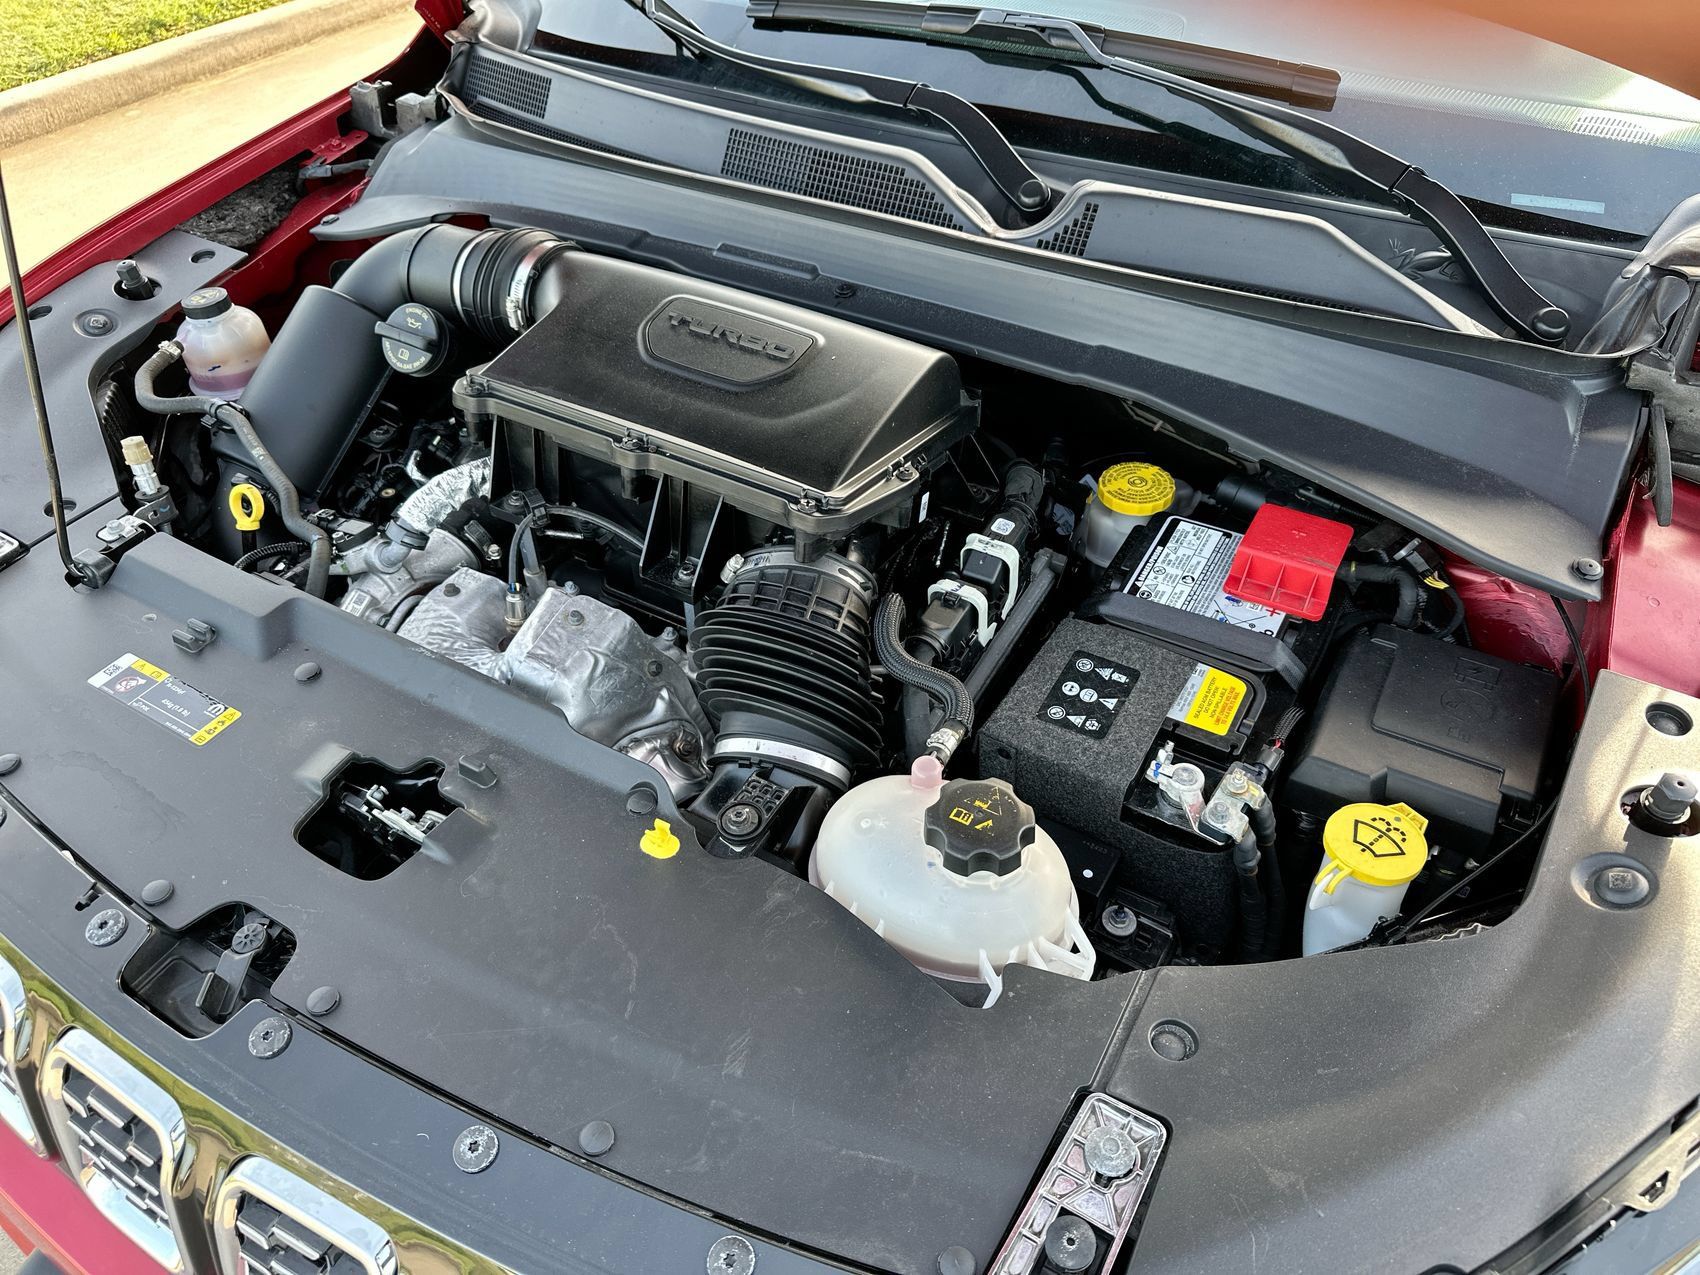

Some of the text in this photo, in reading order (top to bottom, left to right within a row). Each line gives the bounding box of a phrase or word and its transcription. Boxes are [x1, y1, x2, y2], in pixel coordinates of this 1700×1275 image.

[668, 311, 796, 360] TURBO
[1194, 702, 1205, 719] SEALED
[1206, 677, 1217, 694] BATTERY
[1211, 686, 1220, 698] OPEN
